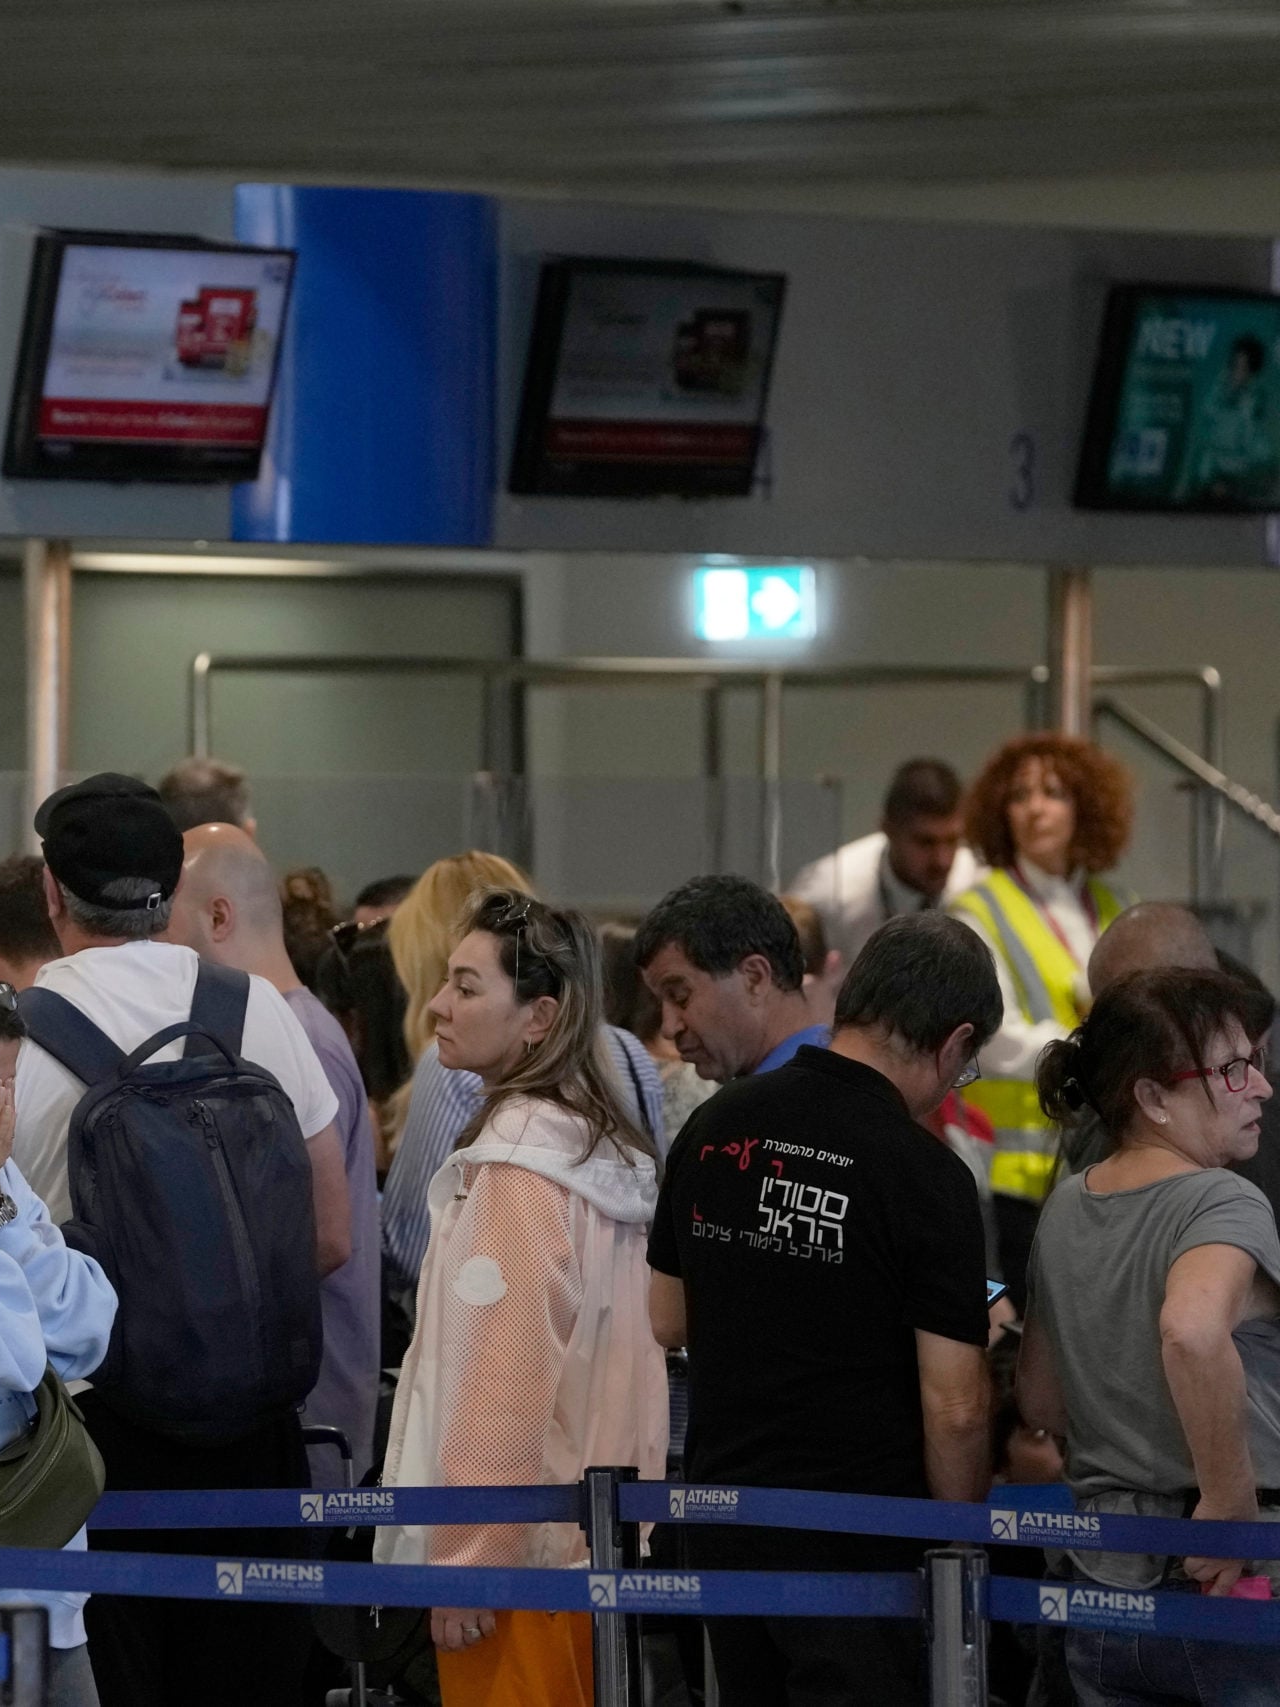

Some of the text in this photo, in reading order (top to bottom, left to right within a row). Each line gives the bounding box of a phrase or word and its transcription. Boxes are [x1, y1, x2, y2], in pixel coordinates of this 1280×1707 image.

[1136, 315, 1217, 359] NEW
[762, 1139, 815, 1158] מהמסגרת
[816, 1150, 854, 1168] יוצאים
[758, 1203, 844, 1249] הראל
[325, 1492, 395, 1507] ATHENS
[686, 1489, 739, 1504] ATHENS
[1020, 1511, 1101, 1531] ATHENS
[245, 1562, 324, 1581] ATHENS
[619, 1575, 702, 1592] ATHENS
[1070, 1589, 1156, 1612] ATHENS
